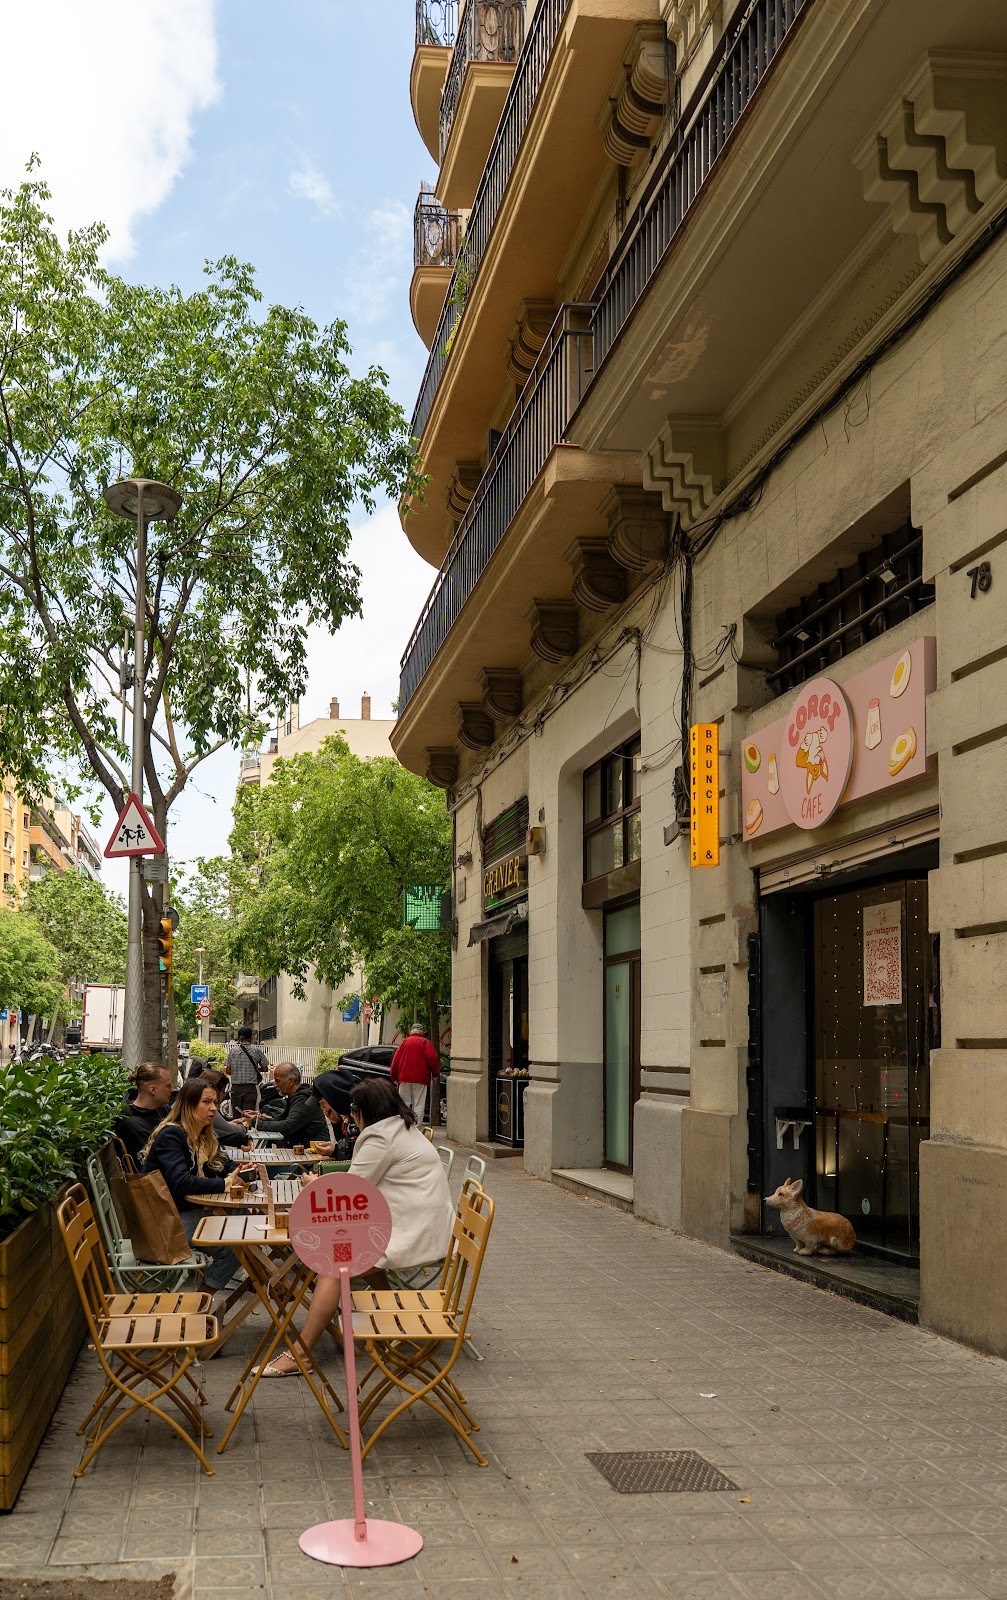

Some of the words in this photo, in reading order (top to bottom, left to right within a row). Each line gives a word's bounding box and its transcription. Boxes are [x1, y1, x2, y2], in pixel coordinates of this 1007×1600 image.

[967, 561, 992, 598] 78
[705, 730, 713, 814] BRUNCH
[801, 792, 823, 819] CAFE
[705, 850, 713, 860] &
[484, 855, 520, 899] GRANIER
[310, 1188, 369, 1213] Line
[311, 1213, 343, 1223] starts
[345, 1212, 370, 1221] here
